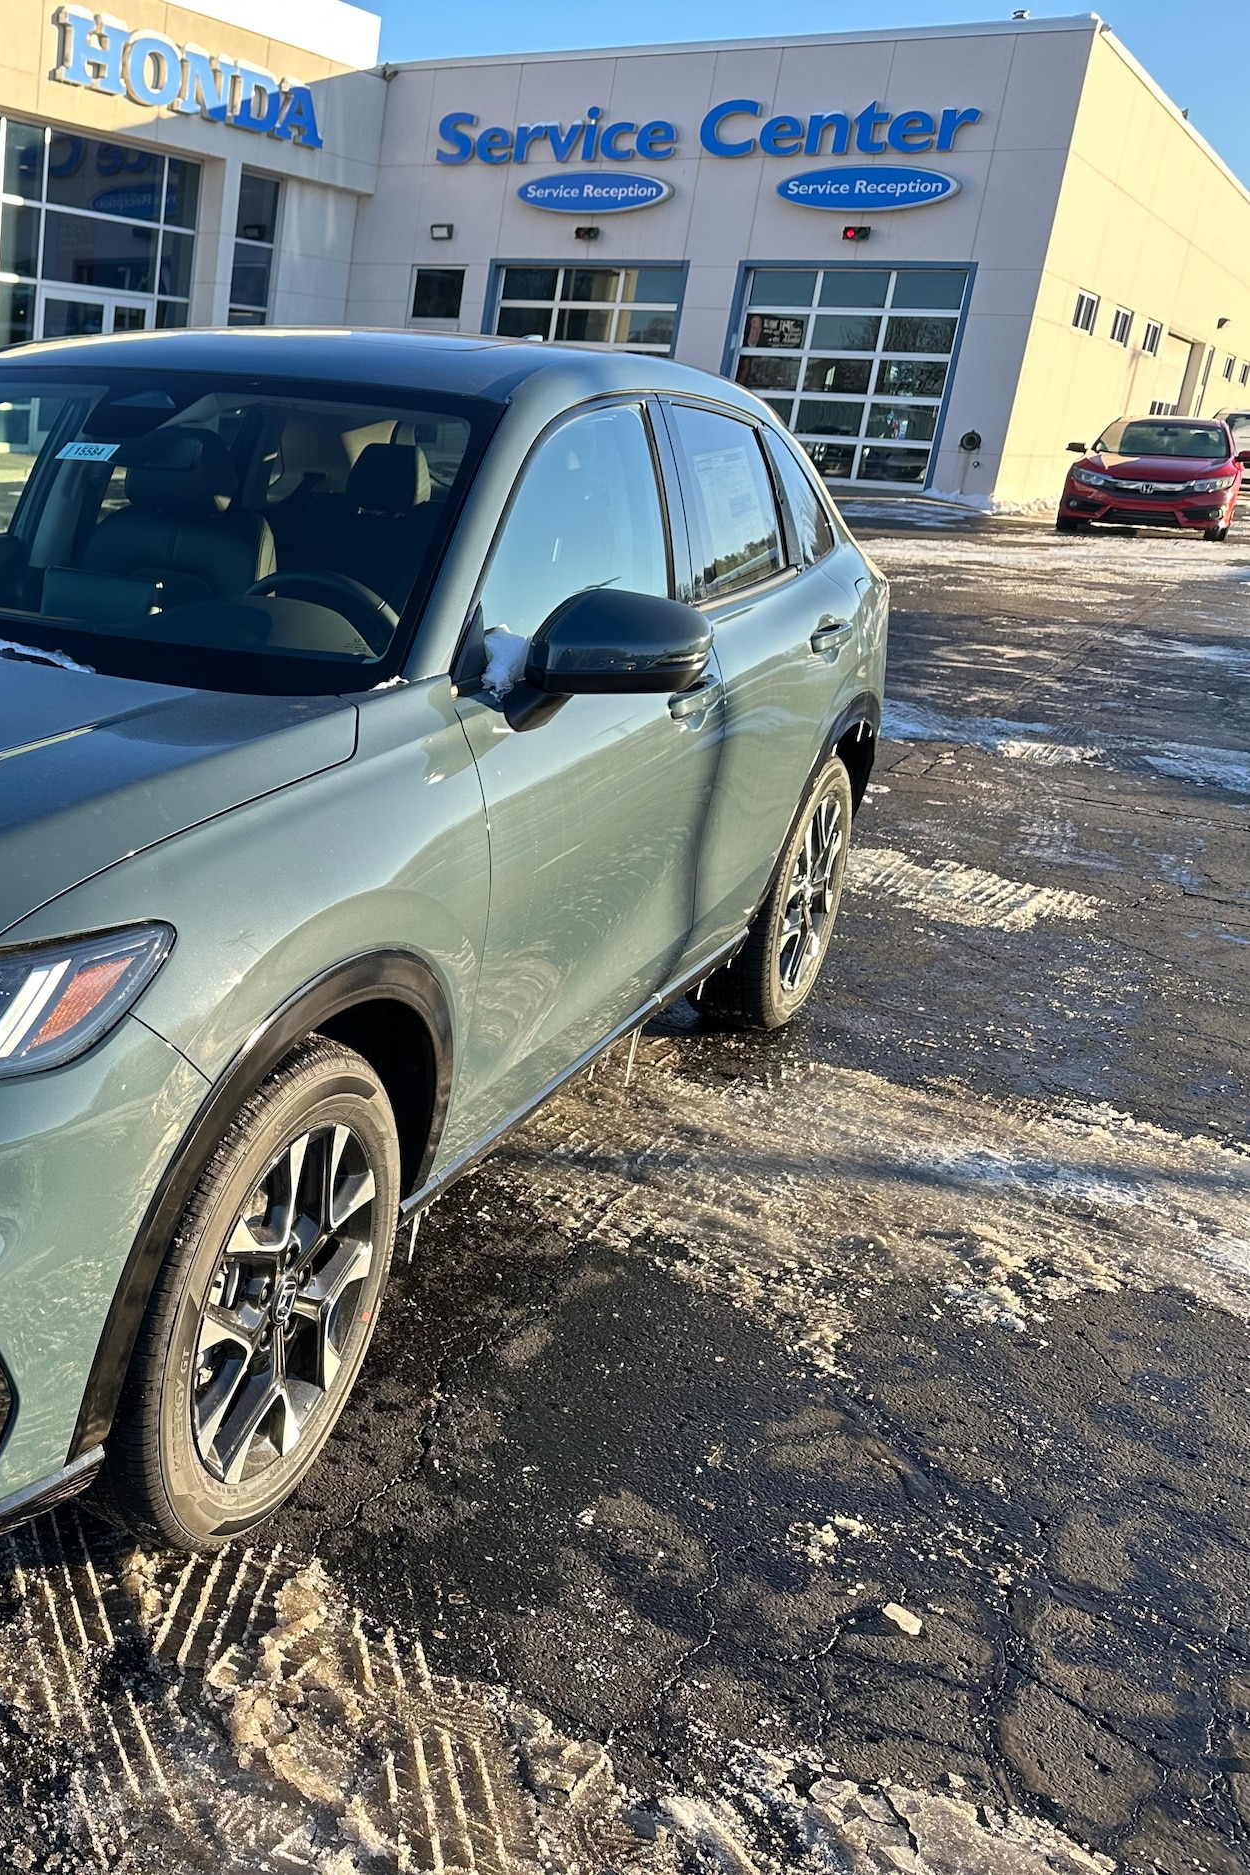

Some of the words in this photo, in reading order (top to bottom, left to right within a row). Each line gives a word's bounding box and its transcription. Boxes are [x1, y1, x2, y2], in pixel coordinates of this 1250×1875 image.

[52, 8, 323, 148] HONDA
[435, 106, 676, 164] Service
[700, 99, 982, 157] Center
[526, 185, 579, 198] Service
[582, 184, 657, 200] Reception
[787, 181, 850, 195] Service
[854, 180, 943, 197] Reception
[74, 446, 105, 456] 15584
[180, 1347, 191, 1375] GT
